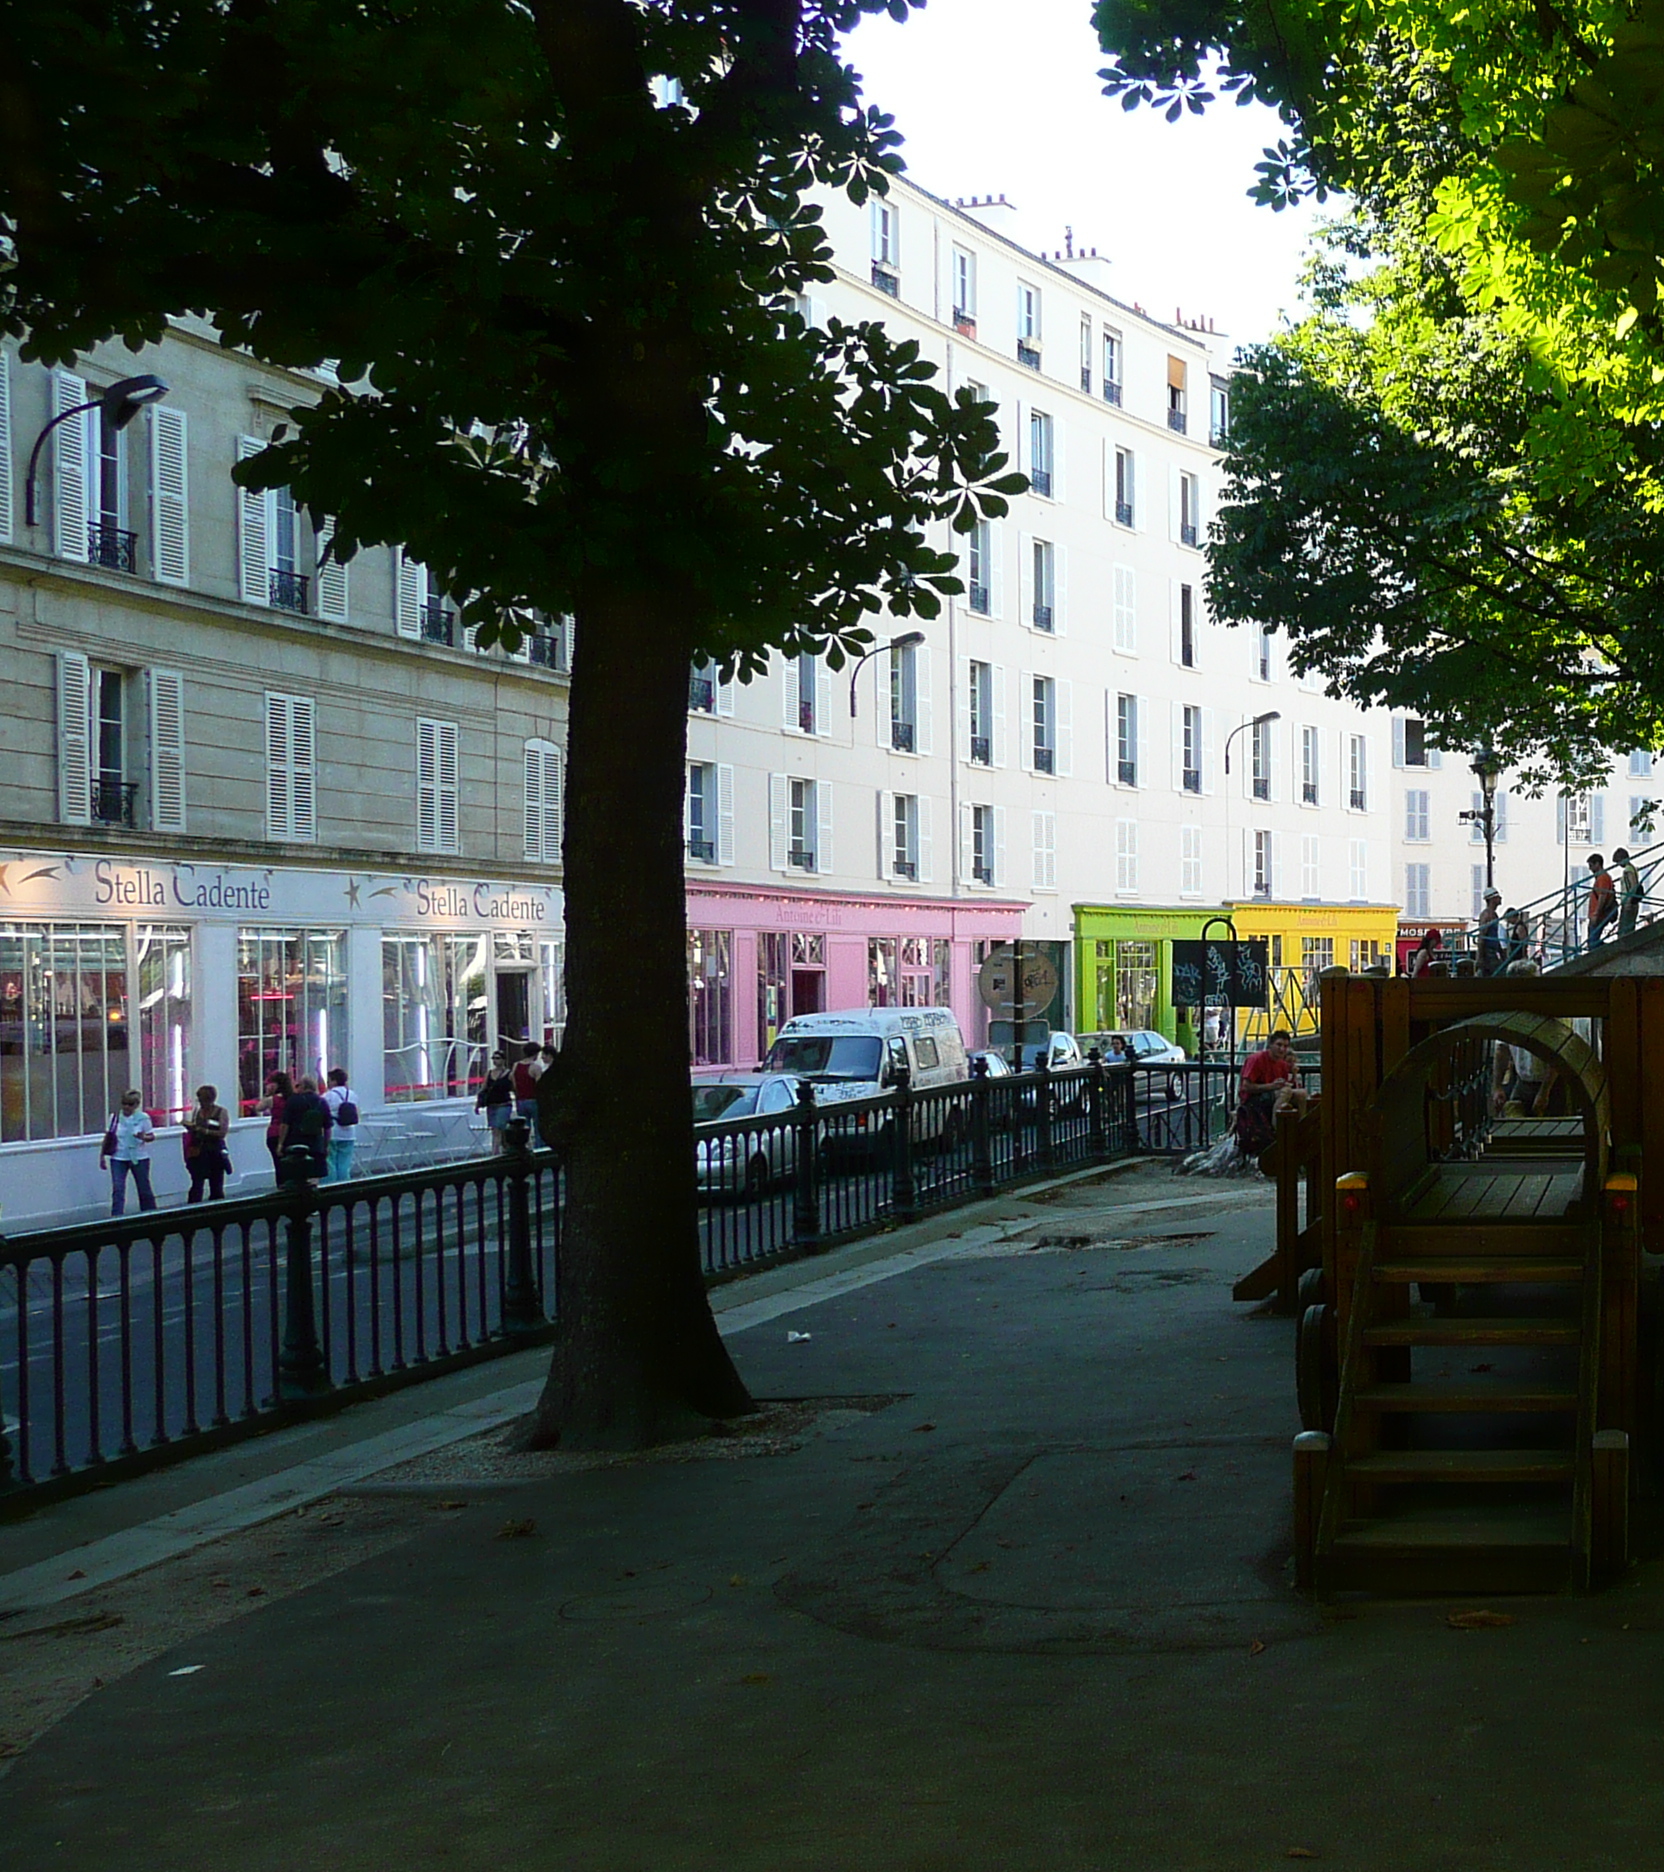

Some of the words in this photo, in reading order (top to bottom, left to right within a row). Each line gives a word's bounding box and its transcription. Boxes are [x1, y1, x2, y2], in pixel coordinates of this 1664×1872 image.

[95, 859, 166, 905] Stella
[172, 863, 270, 909] Cadente
[417, 879, 468, 917] Stella
[474, 883, 545, 921] Cadente
[776, 904, 814, 924] Antoine
